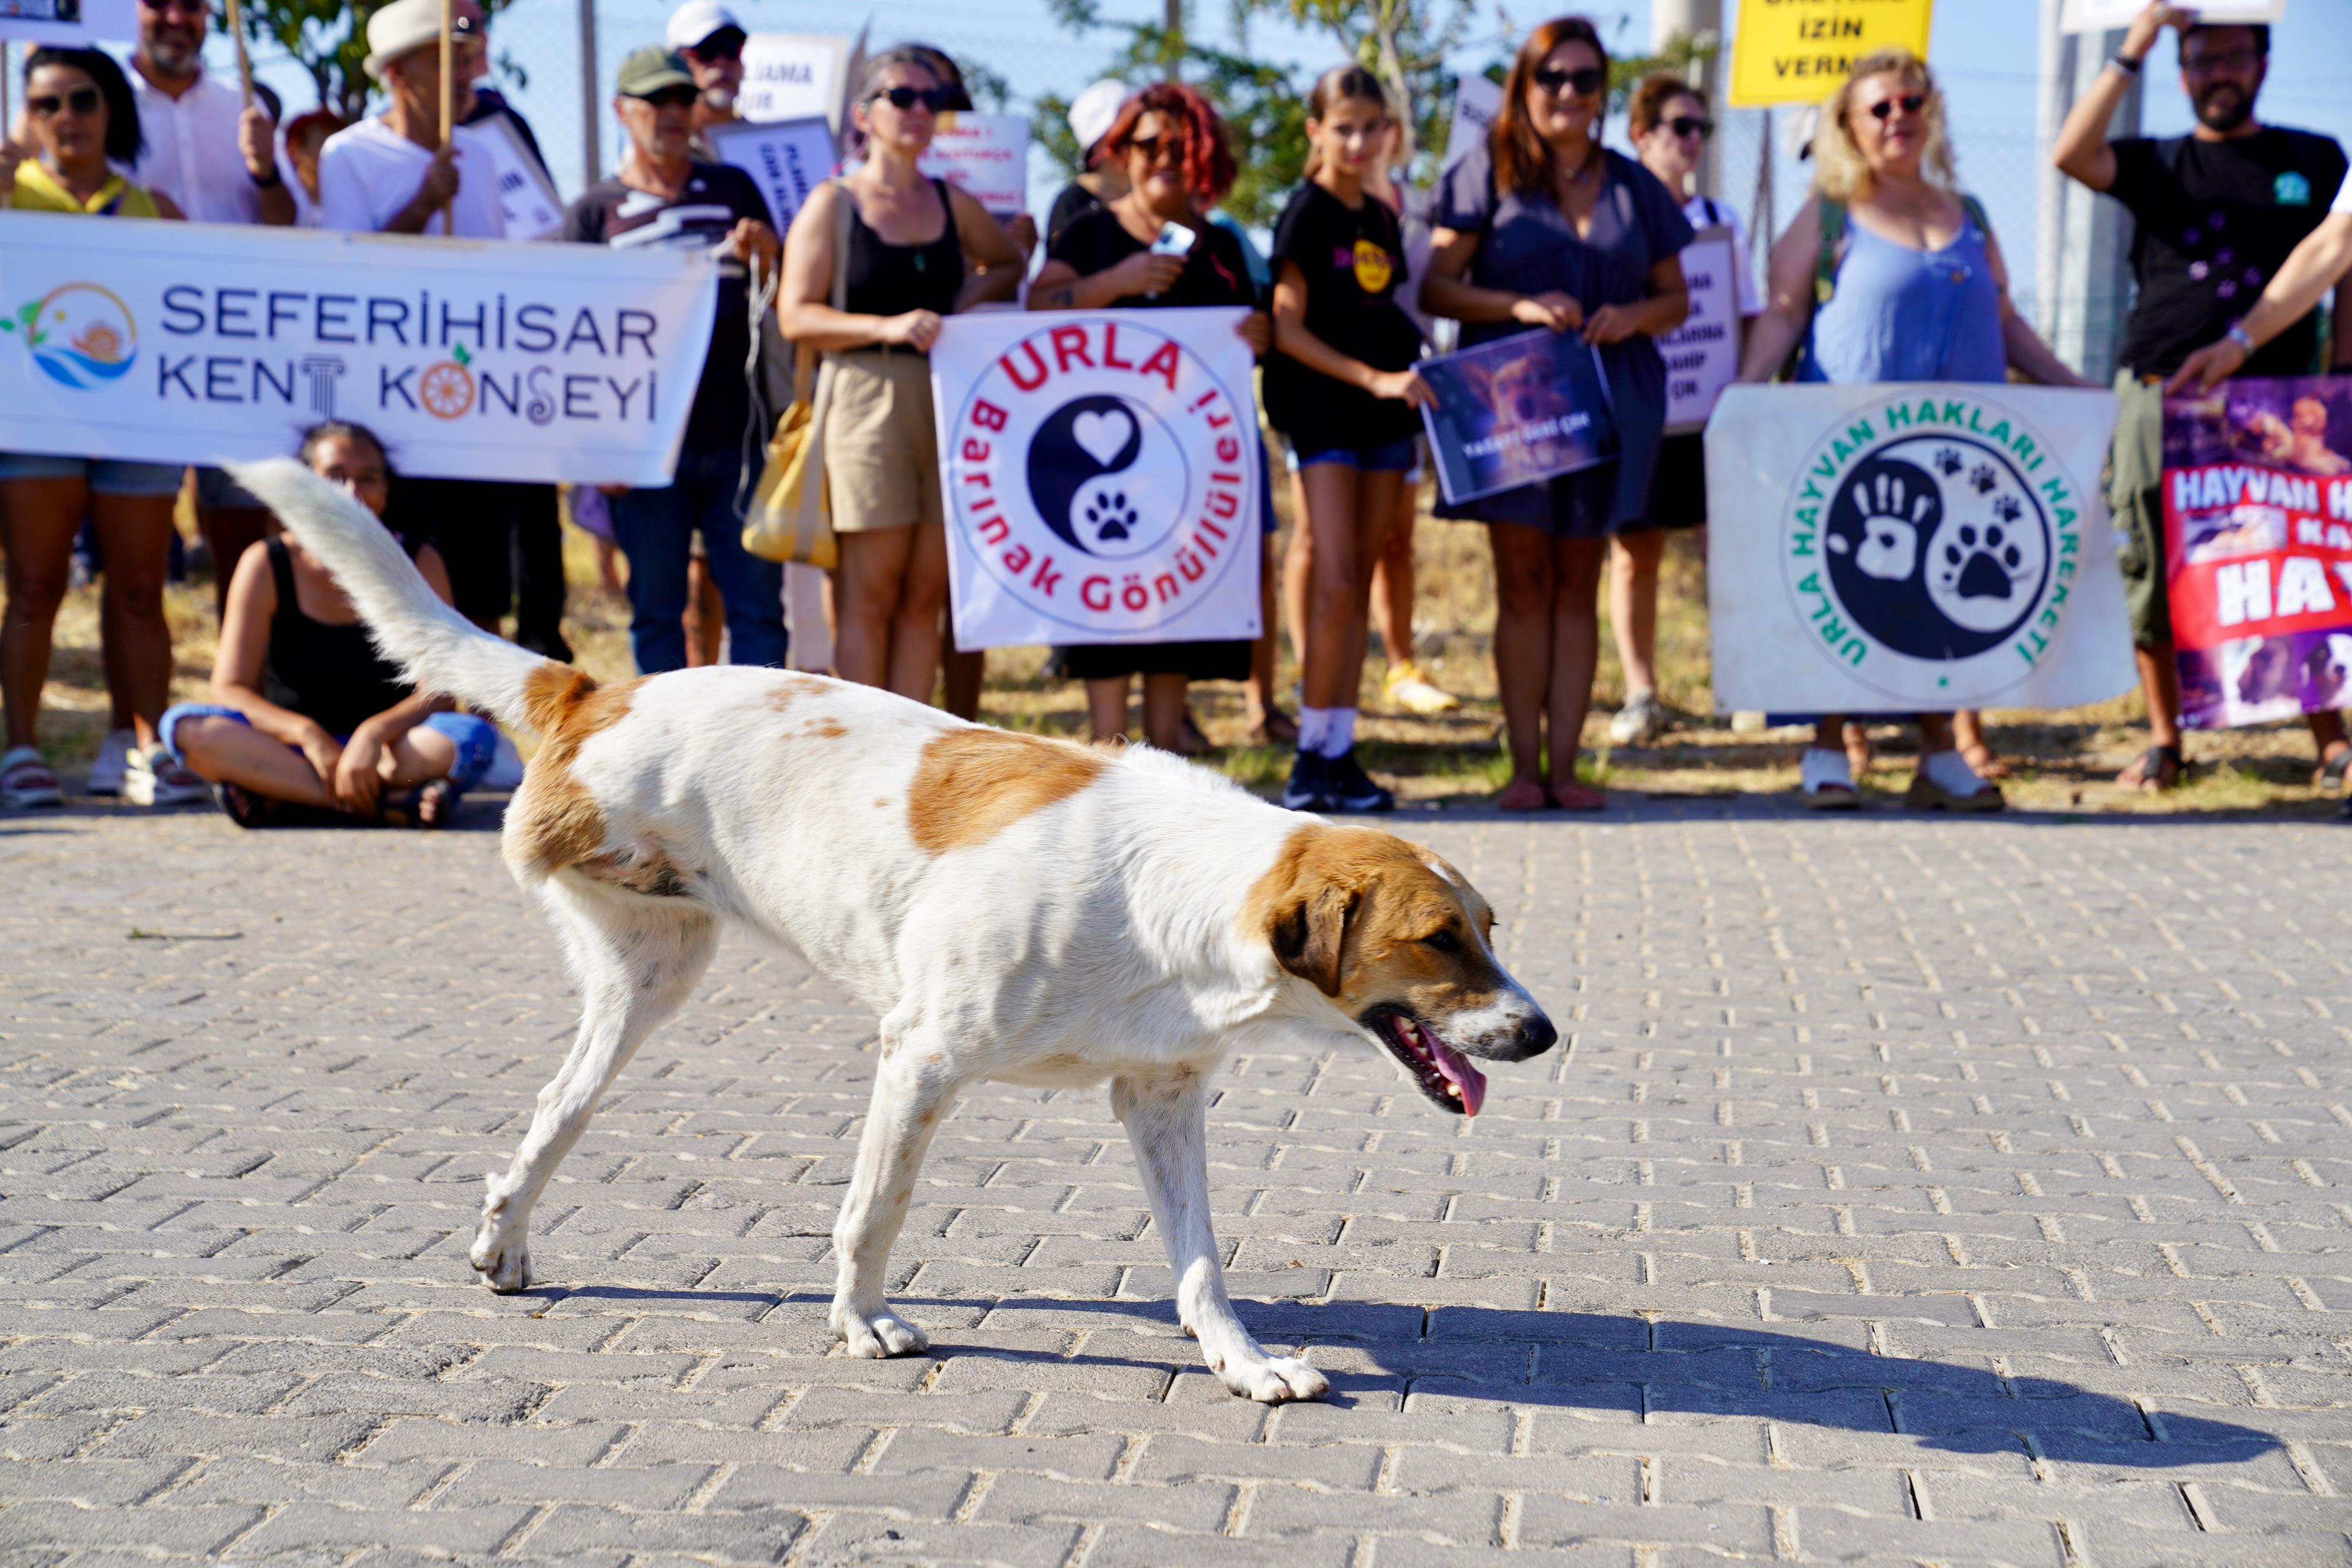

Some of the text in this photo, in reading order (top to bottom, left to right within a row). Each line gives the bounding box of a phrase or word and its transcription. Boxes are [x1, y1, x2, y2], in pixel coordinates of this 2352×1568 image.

[1800, 11, 1863, 39] İZİN
[1774, 55, 1854, 77] VERM
[161, 285, 658, 358] SEFERİHİSAR
[999, 322, 1182, 392] URLA
[157, 353, 655, 426] KENT KONSEYİ
[1886, 400, 2044, 471] HAKLARI
[963, 397, 1063, 598] Barınak
[1793, 418, 1874, 556] HAYVAN
[2174, 466, 2319, 512] HAYVAN
[1799, 571, 1867, 666] URLA
